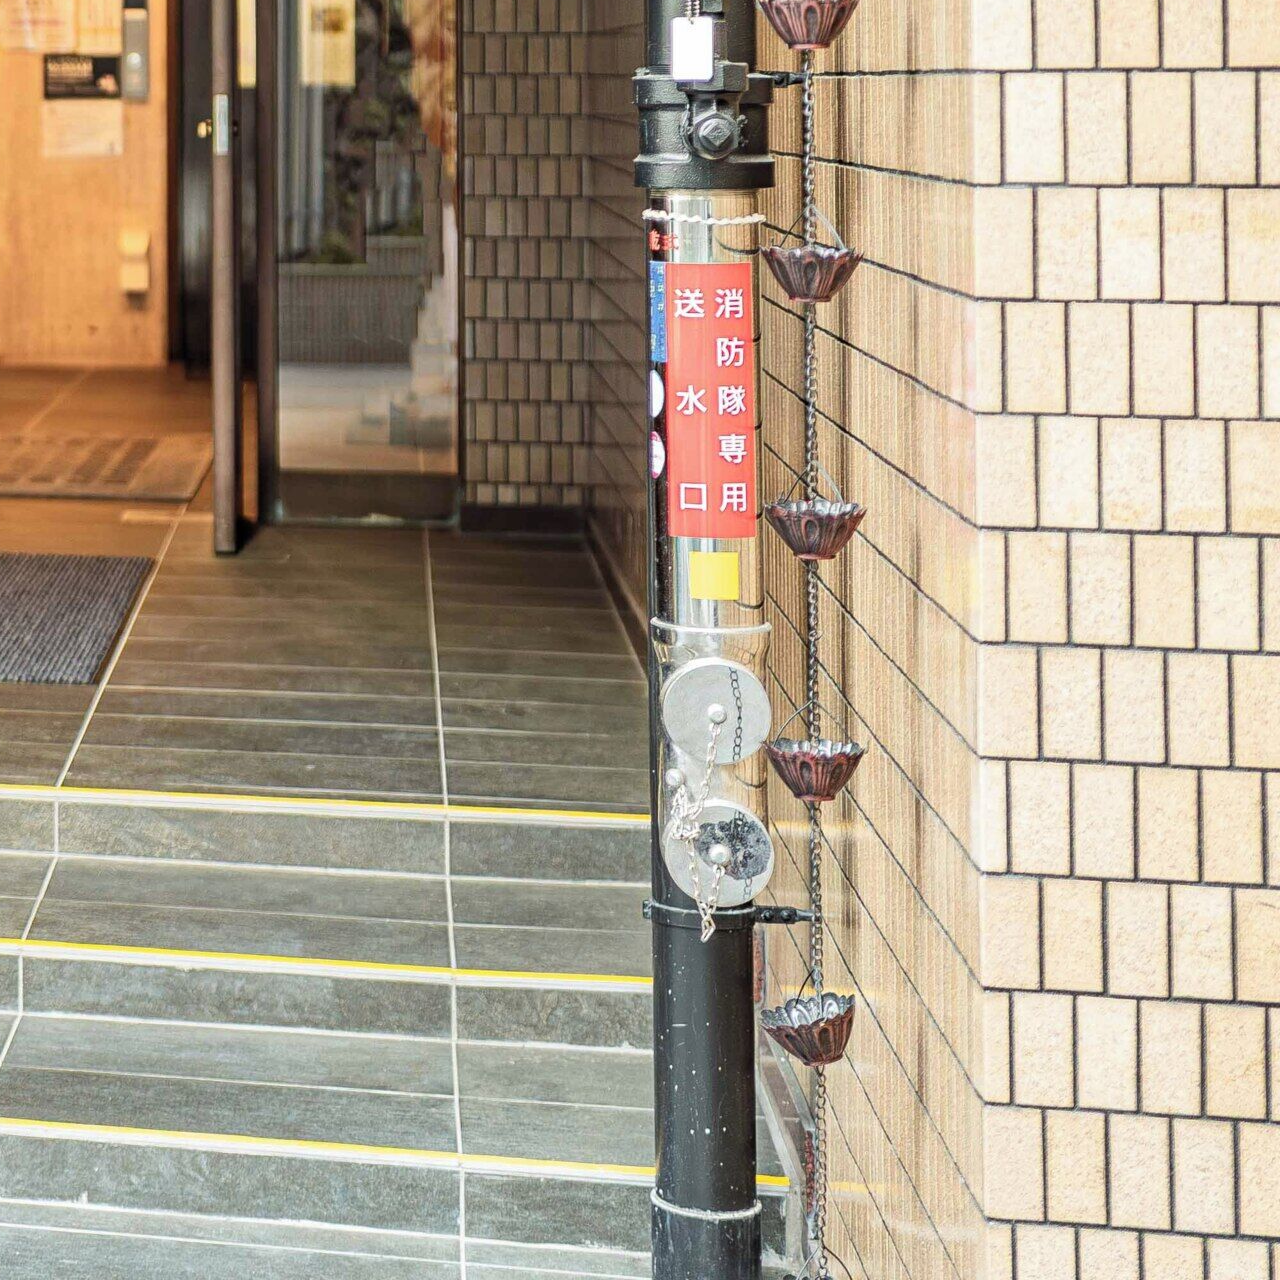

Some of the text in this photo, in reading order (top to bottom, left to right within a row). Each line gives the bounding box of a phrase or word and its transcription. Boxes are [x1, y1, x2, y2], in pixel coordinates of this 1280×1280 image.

[673, 288, 708, 512] 送水口
[714, 288, 748, 513] 消防隊専用
